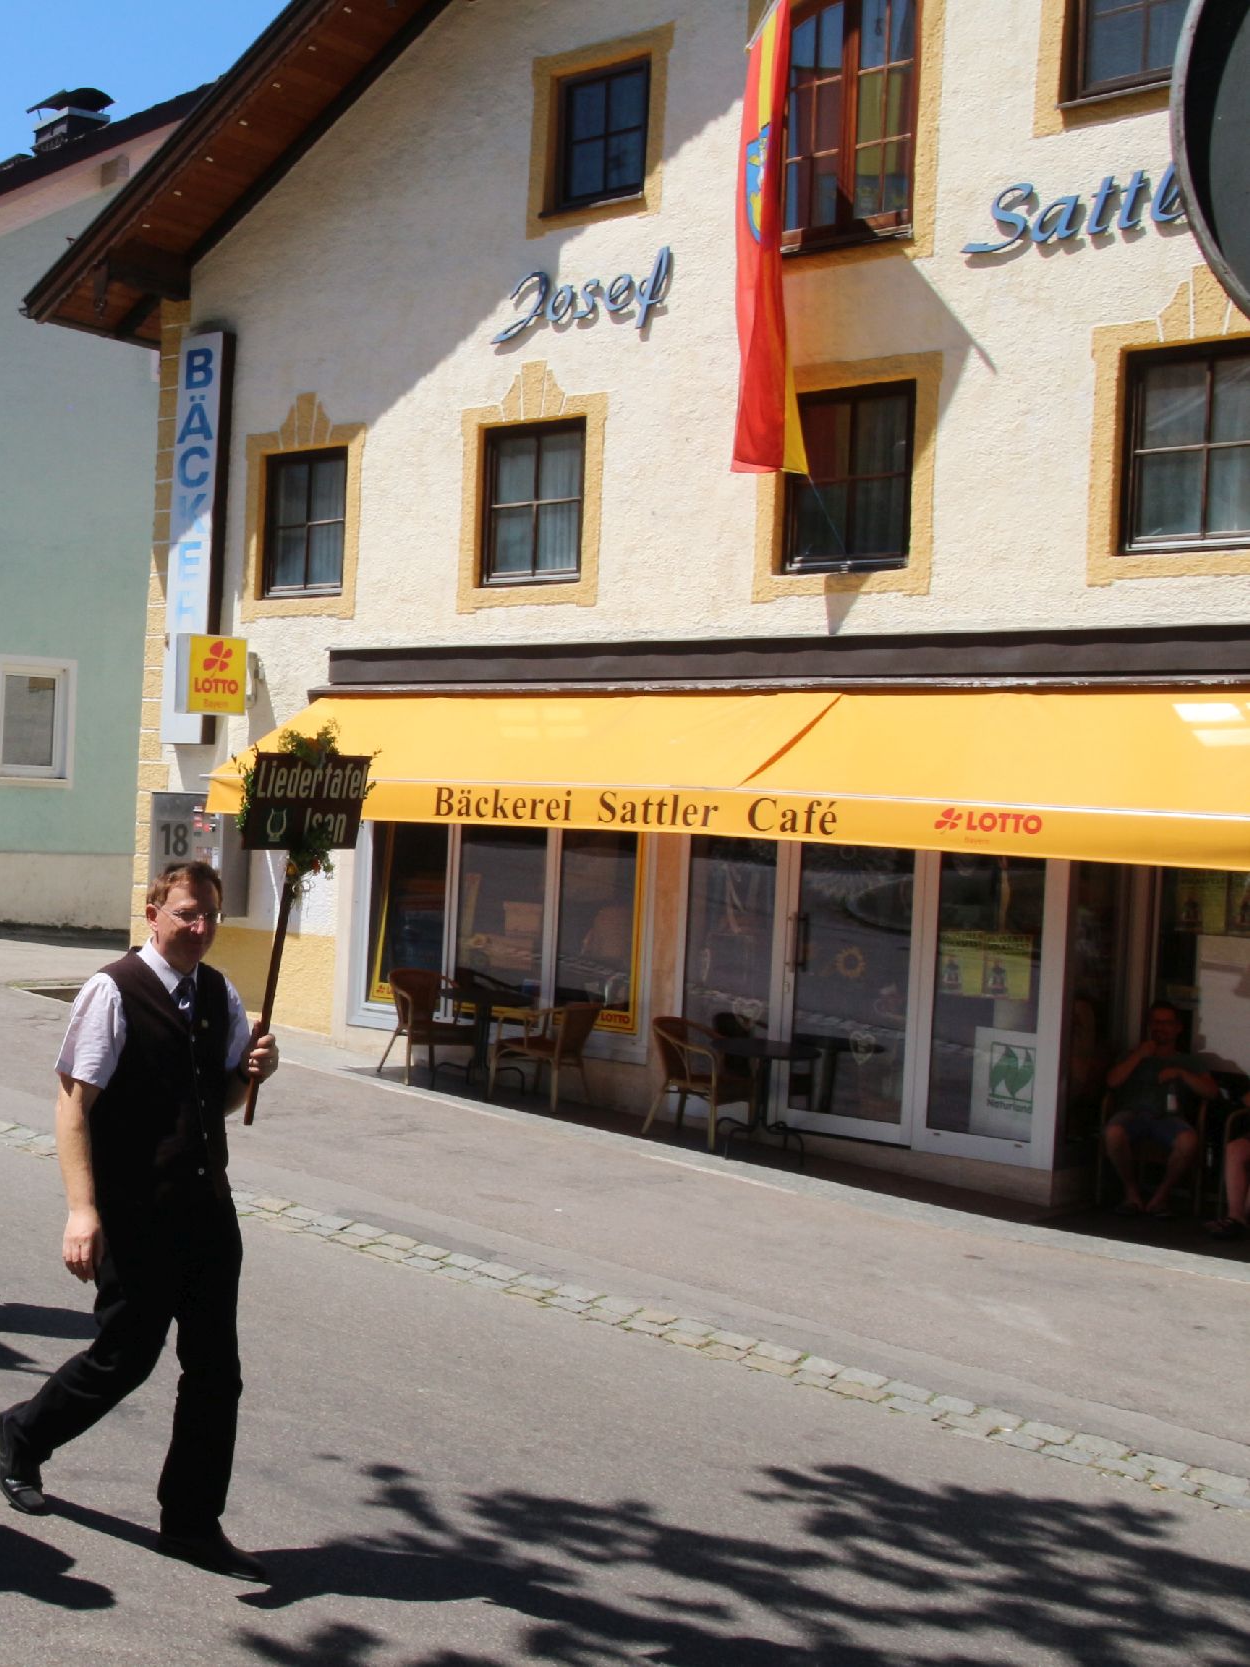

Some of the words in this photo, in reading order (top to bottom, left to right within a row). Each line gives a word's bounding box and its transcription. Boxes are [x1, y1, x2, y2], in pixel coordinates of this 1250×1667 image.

[490, 246, 670, 344] Josef
[194, 677, 238, 694] LOTTO
[256, 760, 368, 799] Liedertafel
[433, 786, 572, 822] Bäckerei
[597, 790, 719, 828] Sattler
[747, 797, 838, 836] Café
[966, 811, 1042, 835] LOTTO
[161, 823, 189, 857] 18
[601, 1013, 630, 1025] LOTTO
